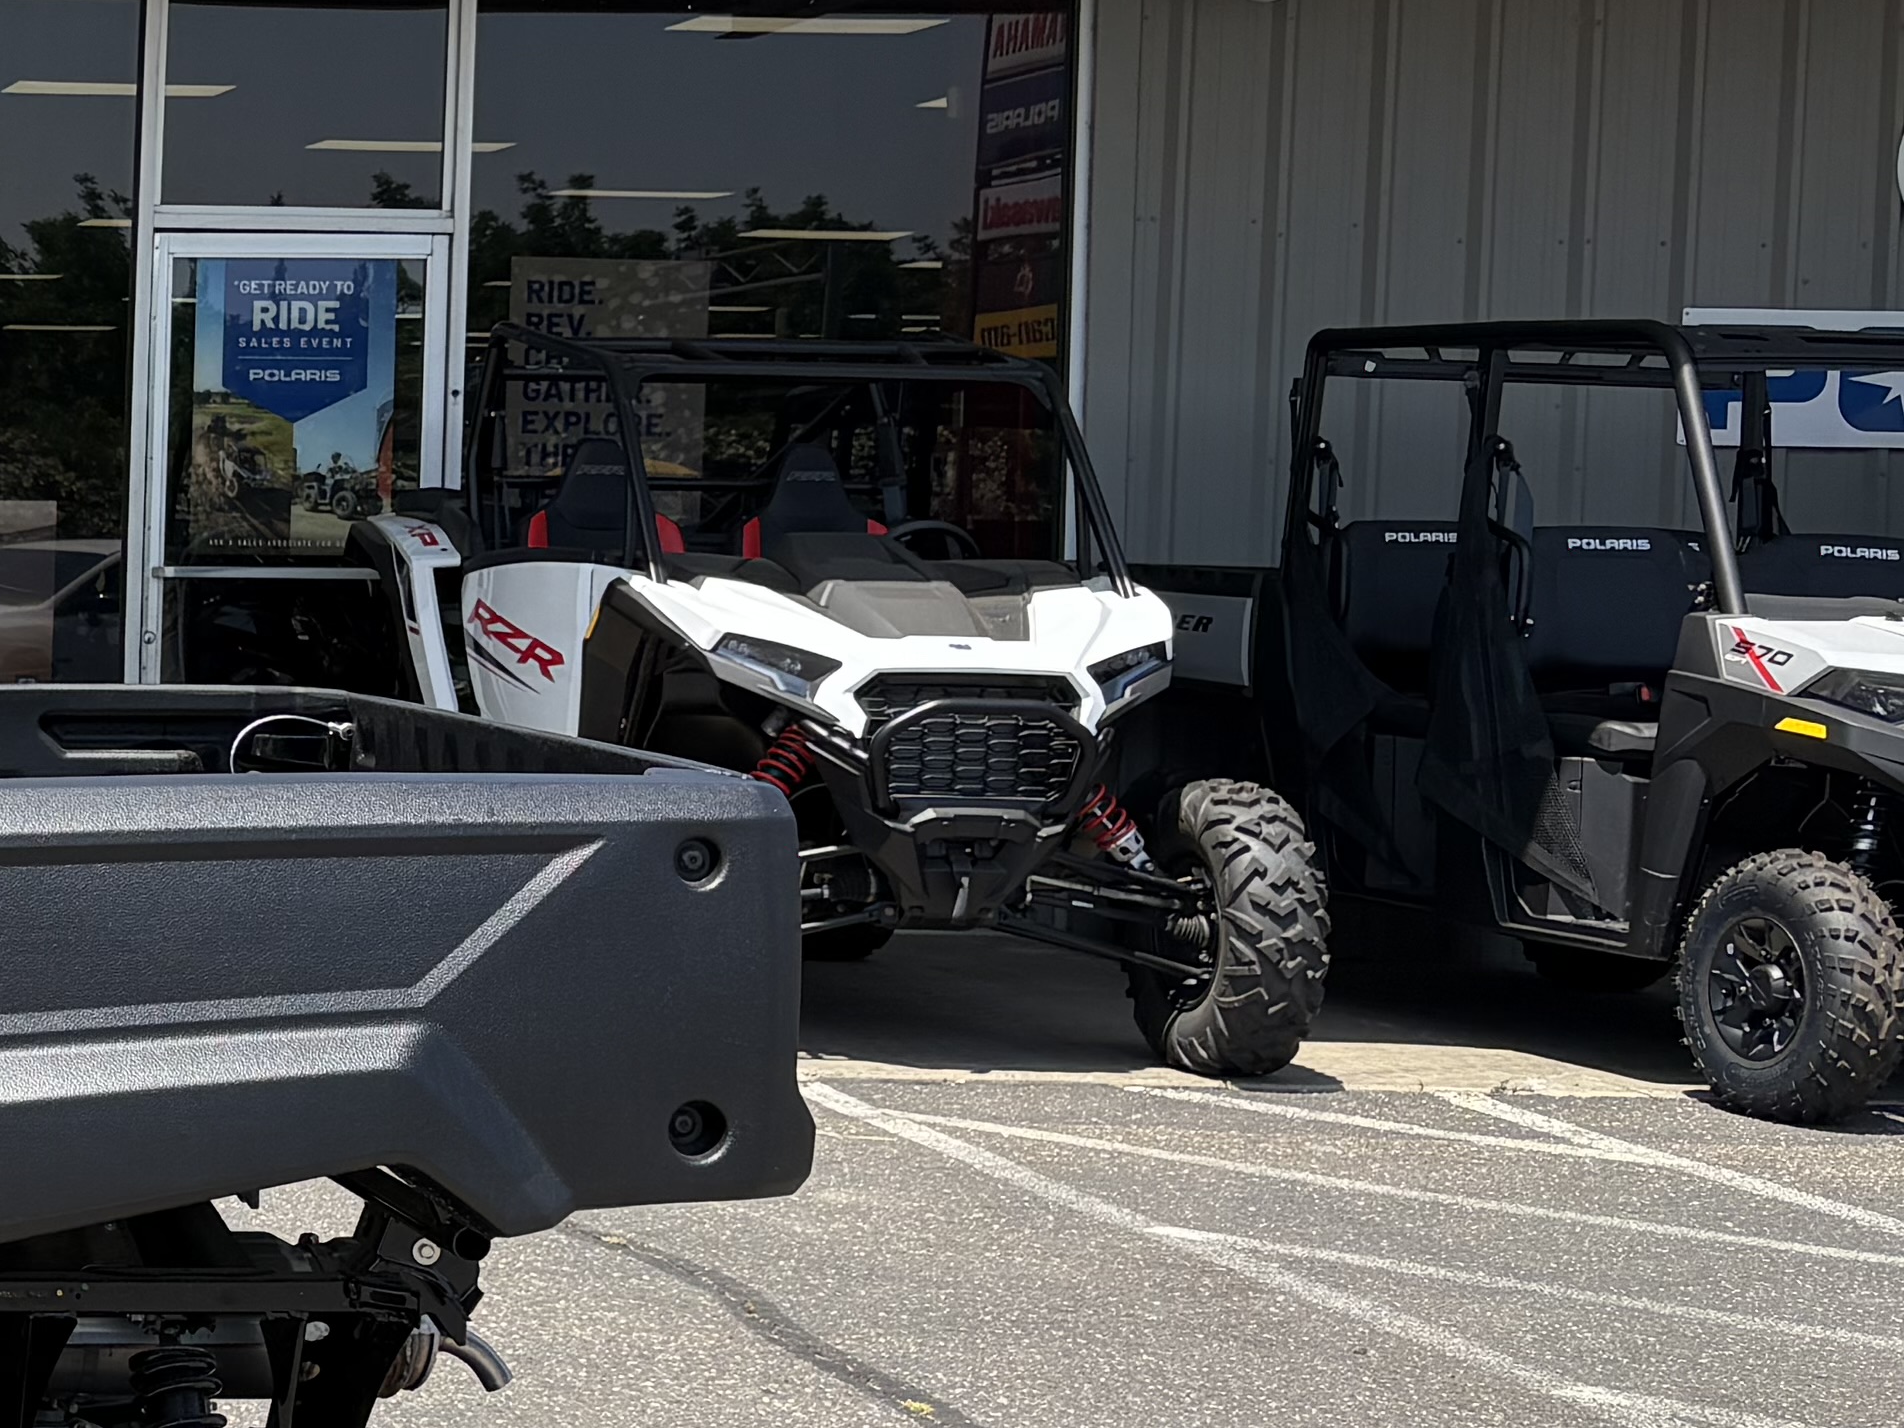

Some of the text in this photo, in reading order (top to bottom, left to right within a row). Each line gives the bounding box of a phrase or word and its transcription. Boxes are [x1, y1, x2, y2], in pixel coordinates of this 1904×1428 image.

[275, 280, 330, 295] READY
[334, 280, 355, 295] TO
[526, 279, 604, 305] RIDE.
[252, 300, 341, 332] RIDE
[525, 313, 592, 337] REV.
[238, 337, 353, 349] SALES EVENT
[249, 369, 341, 382] POLARIS
[403, 524, 440, 547] XP
[1567, 537, 1652, 552] POLARIS
[1820, 544, 1901, 561] POLARIS
[467, 597, 565, 684] RZR
[1731, 640, 1794, 667] 570
